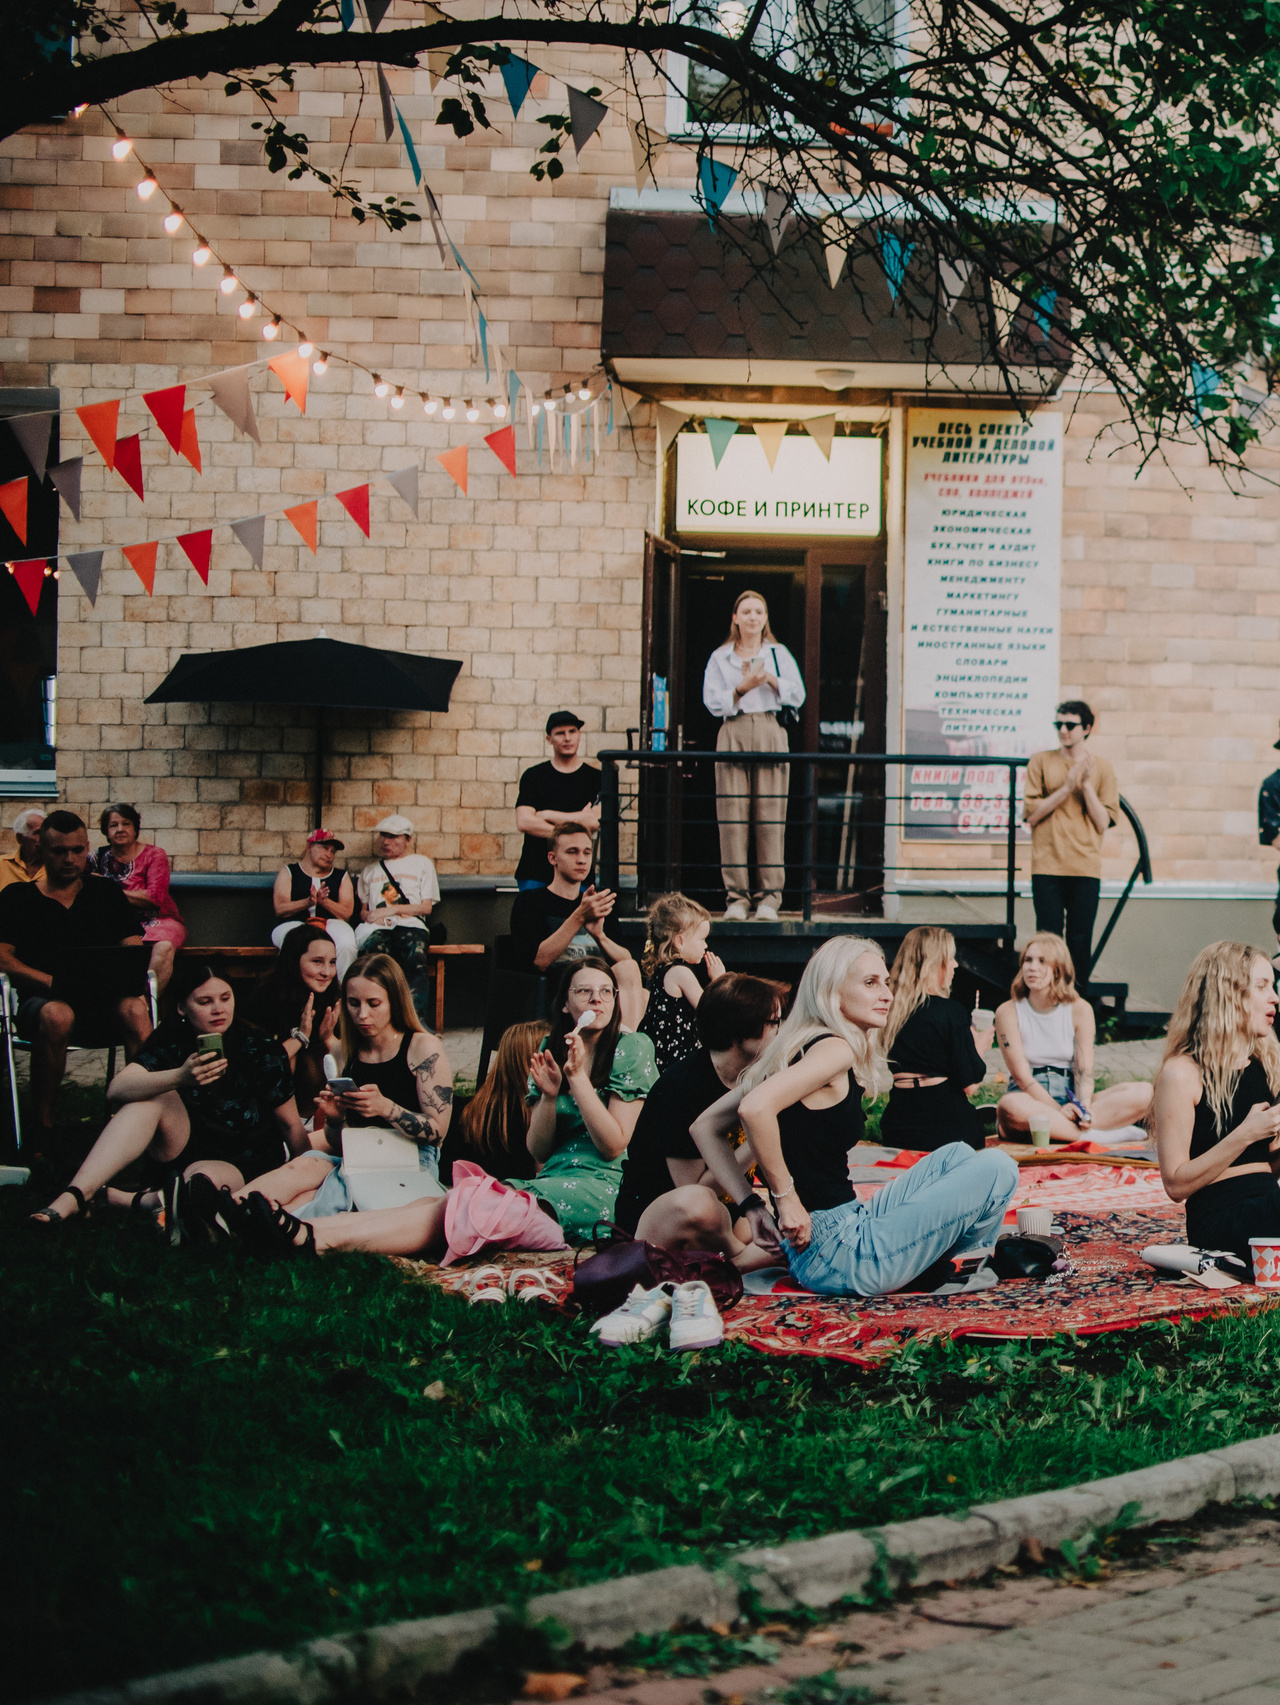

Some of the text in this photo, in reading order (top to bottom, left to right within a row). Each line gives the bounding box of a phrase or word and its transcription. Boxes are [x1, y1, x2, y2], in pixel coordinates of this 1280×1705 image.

[938, 423, 1030, 436] ВЕСЬ СПЕКТР
[912, 436, 1055, 452] УЧЕБНОЙ И ДЕЛОВОЙ
[942, 452, 1030, 465] ЛИТЕРАТУРЫ
[687, 499, 870, 519] КОФЕ И ПРИНТЕР
[941, 509, 1027, 519] ЮРИДИЧЕСКАЯ
[932, 526, 1032, 535] ЭКОНОМИЧЕСКАЯ
[1000, 544, 1037, 552] АУДИТ
[988, 560, 1040, 569] БИЗНЕСУ
[939, 575, 1026, 585] МЕНЕДЖМЕНТУ
[946, 592, 1020, 601] МАРКЕТИНГУ
[936, 608, 1029, 617] ГУМАНИТАРНЫЕ
[922, 625, 1013, 634] ЕСТЕСТВЕННЫЕ
[1017, 627, 1054, 635] НАУКИ
[917, 641, 1047, 651] ИНОСТРАННЫЕ ЯЗЫКИ
[955, 658, 1009, 667] СЛОВАРИ
[935, 674, 1029, 684] ЭНЦИКЛОПЕДИИ
[934, 691, 1029, 700] КОМПЬЮТЕРНАЯ
[941, 707, 1022, 716] ТЕХНИЧЕСКАЯ
[945, 724, 1017, 733] ЛИТЕРАТУРА
[913, 770, 961, 783] КНИГИ
[966, 770, 996, 784] ПОД
